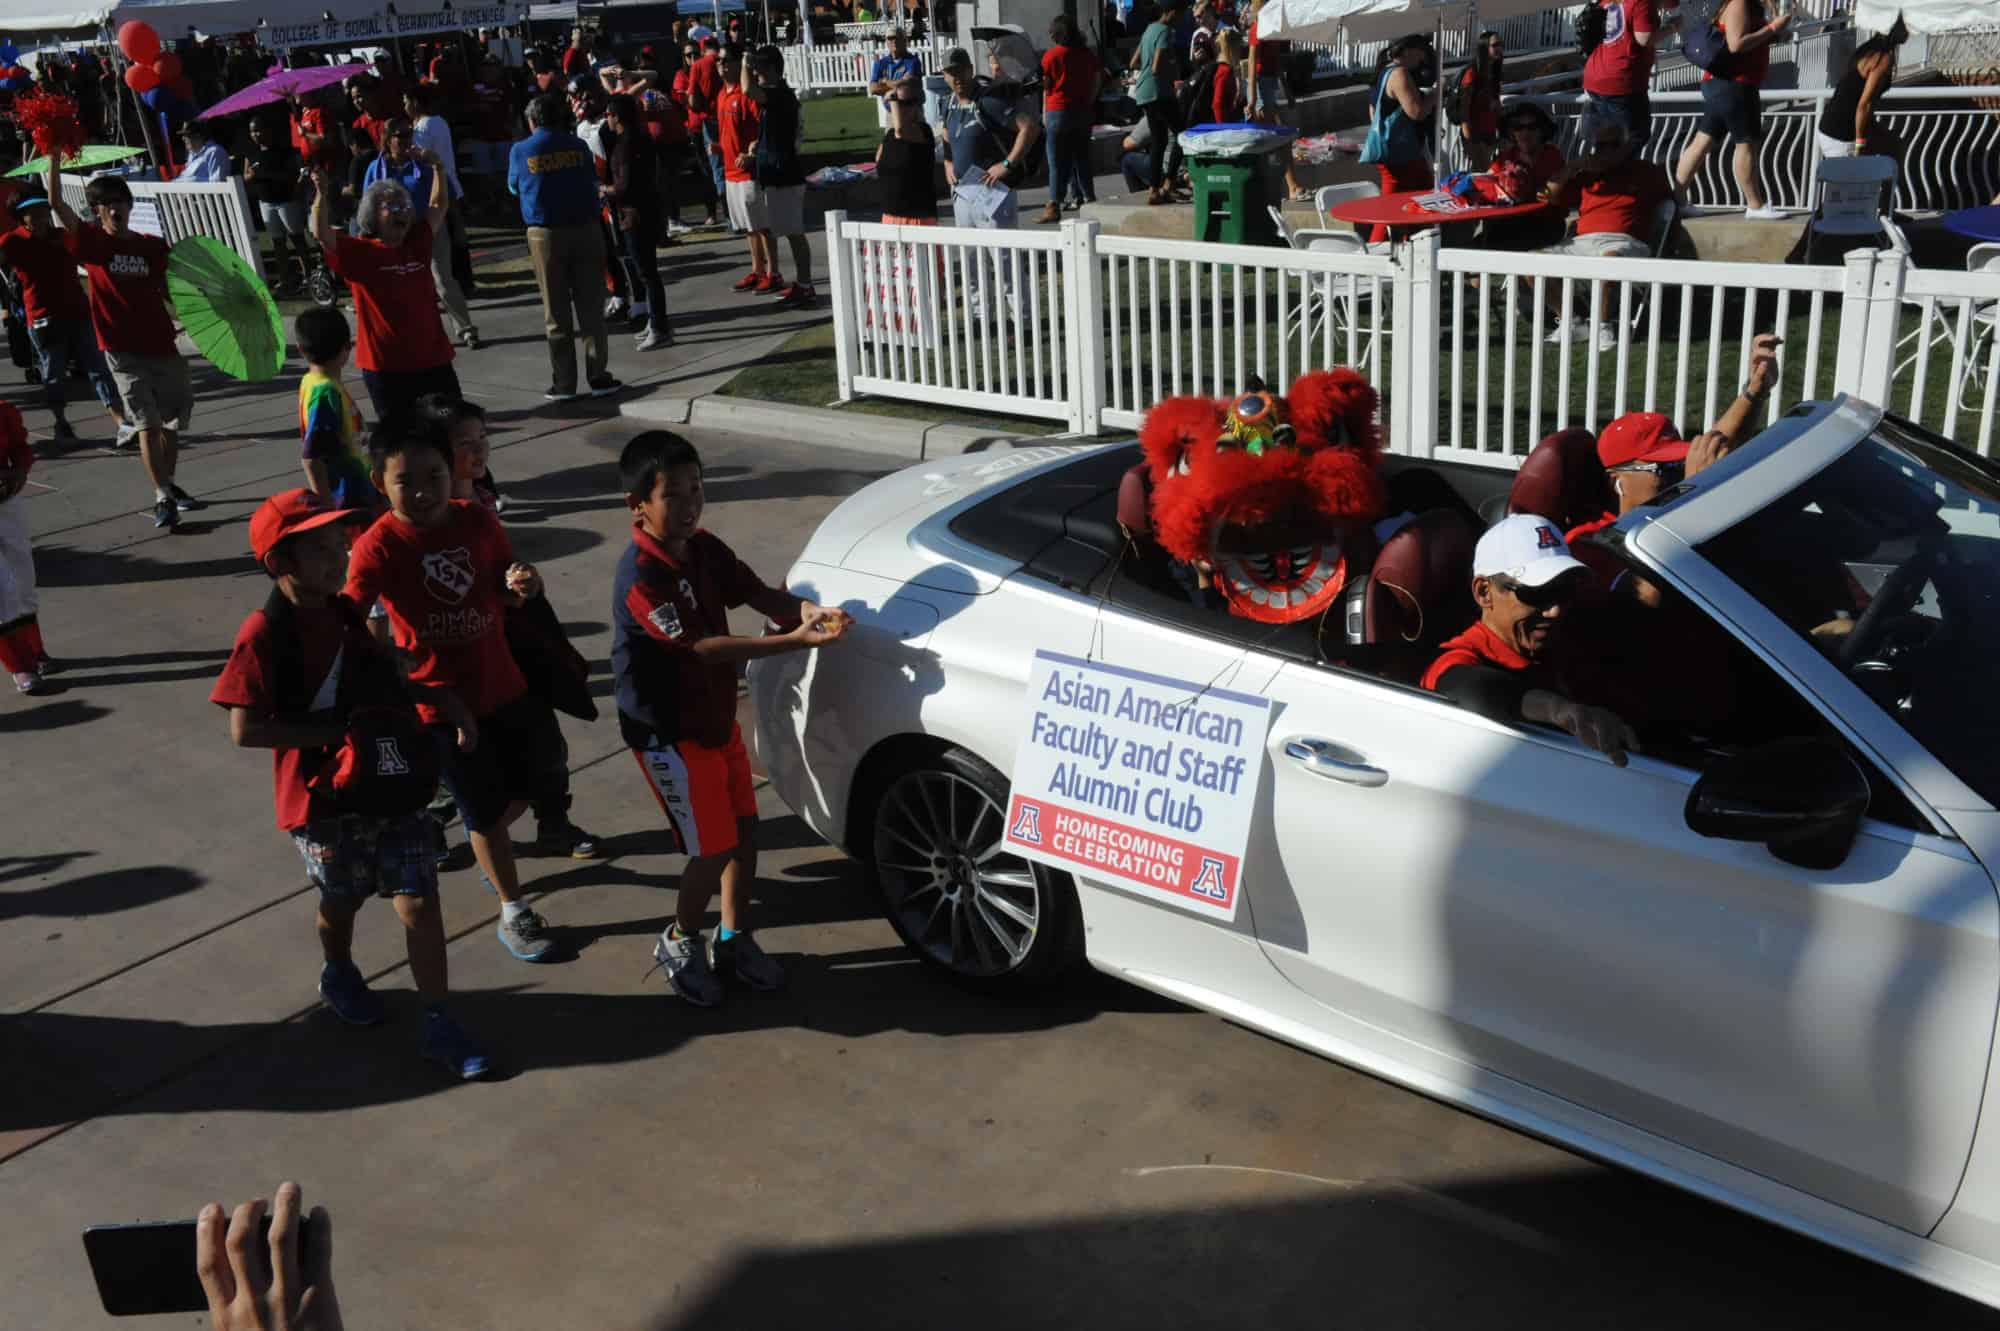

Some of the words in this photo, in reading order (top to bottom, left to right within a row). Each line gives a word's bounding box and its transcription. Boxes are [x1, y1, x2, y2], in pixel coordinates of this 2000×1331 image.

[272, 25, 320, 44] COLLEGE
[325, 23, 337, 40] OF
[344, 18, 381, 37] SOCIAL
[398, 11, 457, 30] BEHAVIORAL
[463, 7, 504, 25] SCIENCES
[529, 150, 585, 173] SECURITY
[110, 262, 149, 275] DOWN
[114, 254, 145, 264] BEAR
[1535, 526, 1561, 549] A
[1042, 670, 1111, 715] Asian
[1115, 687, 1243, 747] American
[376, 736, 409, 776] A
[1032, 711, 1118, 770] Faculty
[1122, 741, 1173, 777] and
[1176, 748, 1246, 795] Staff
[1048, 762, 1140, 816] Alumni
[1144, 788, 1203, 833] Club
[1012, 804, 1042, 843] A
[1055, 813, 1184, 867] HOMECOMING
[1053, 832, 1182, 886] CELEBRATION
[1191, 857, 1226, 900] A
